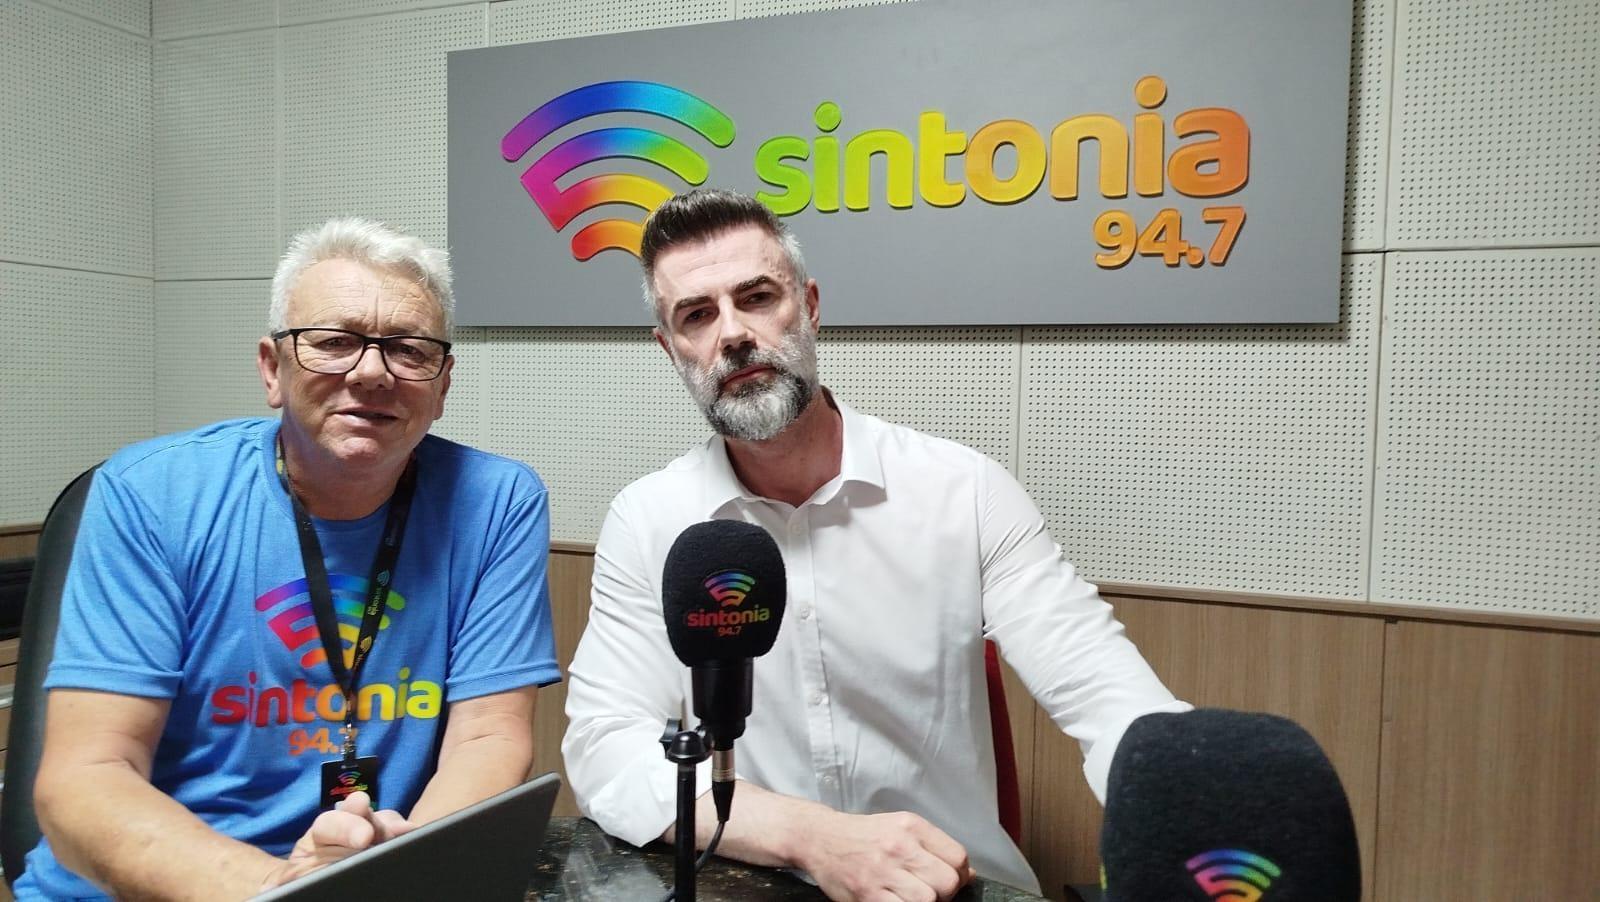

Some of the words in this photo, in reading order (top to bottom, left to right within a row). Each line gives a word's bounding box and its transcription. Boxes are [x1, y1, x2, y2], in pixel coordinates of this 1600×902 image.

[754, 75, 1251, 217] sintonia
[1093, 206, 1247, 270] 94.7
[687, 604, 770, 627] sintonia
[718, 626, 742, 637] 94.7
[210, 667, 442, 727] sintonia
